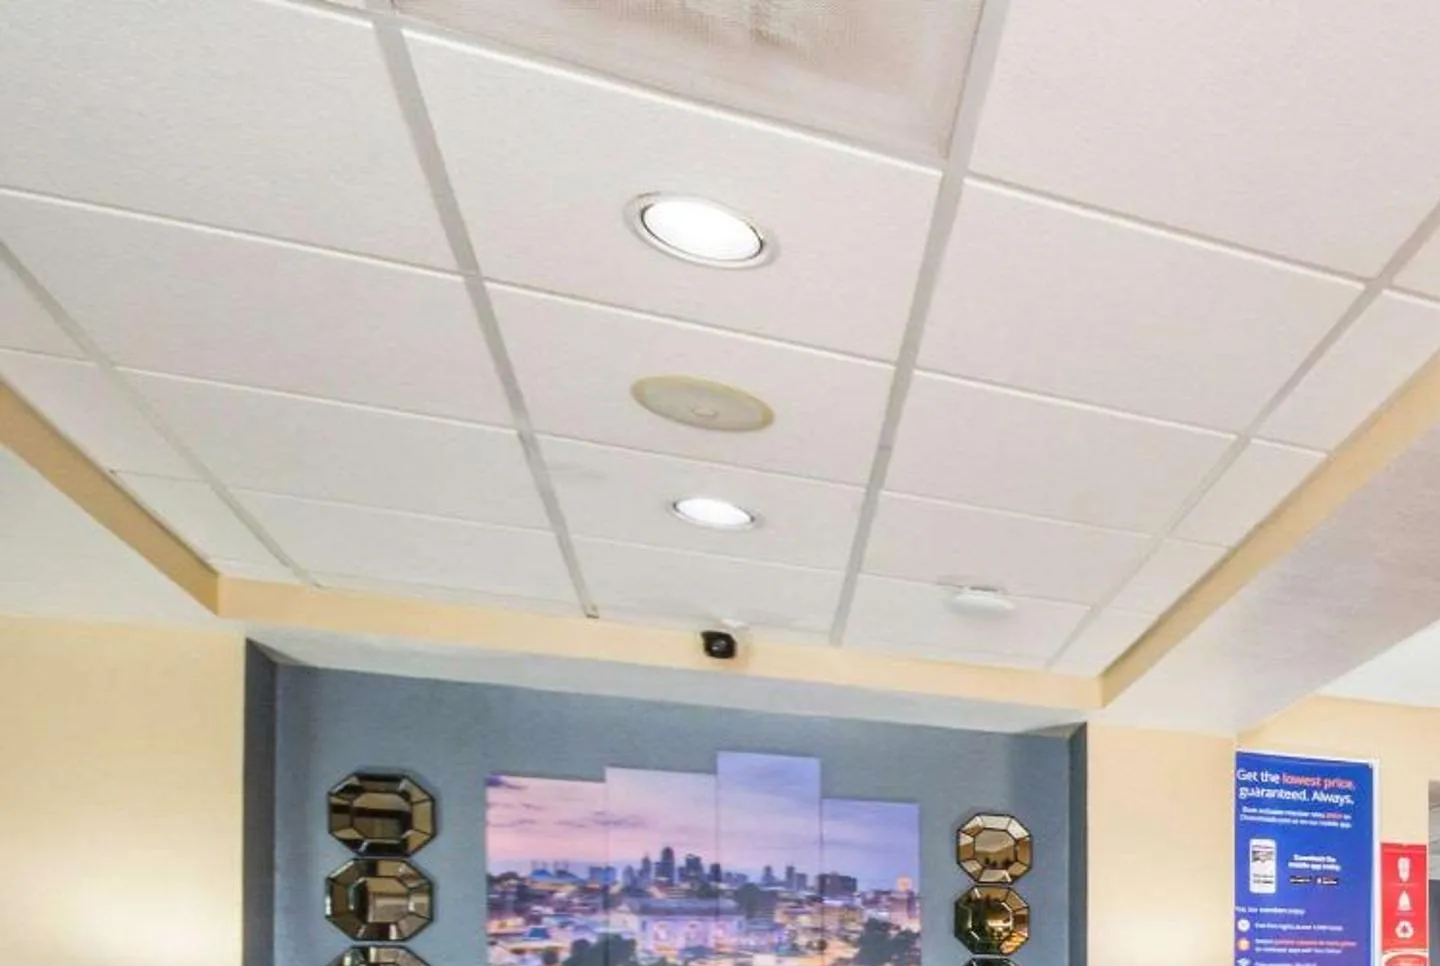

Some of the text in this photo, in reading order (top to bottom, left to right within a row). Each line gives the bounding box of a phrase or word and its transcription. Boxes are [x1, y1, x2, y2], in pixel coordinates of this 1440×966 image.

[1237, 768, 1258, 782] Get
[1261, 770, 1280, 785] the
[1282, 773, 1321, 787] lowest
[1239, 786, 1354, 807] guaranteed. Always.
